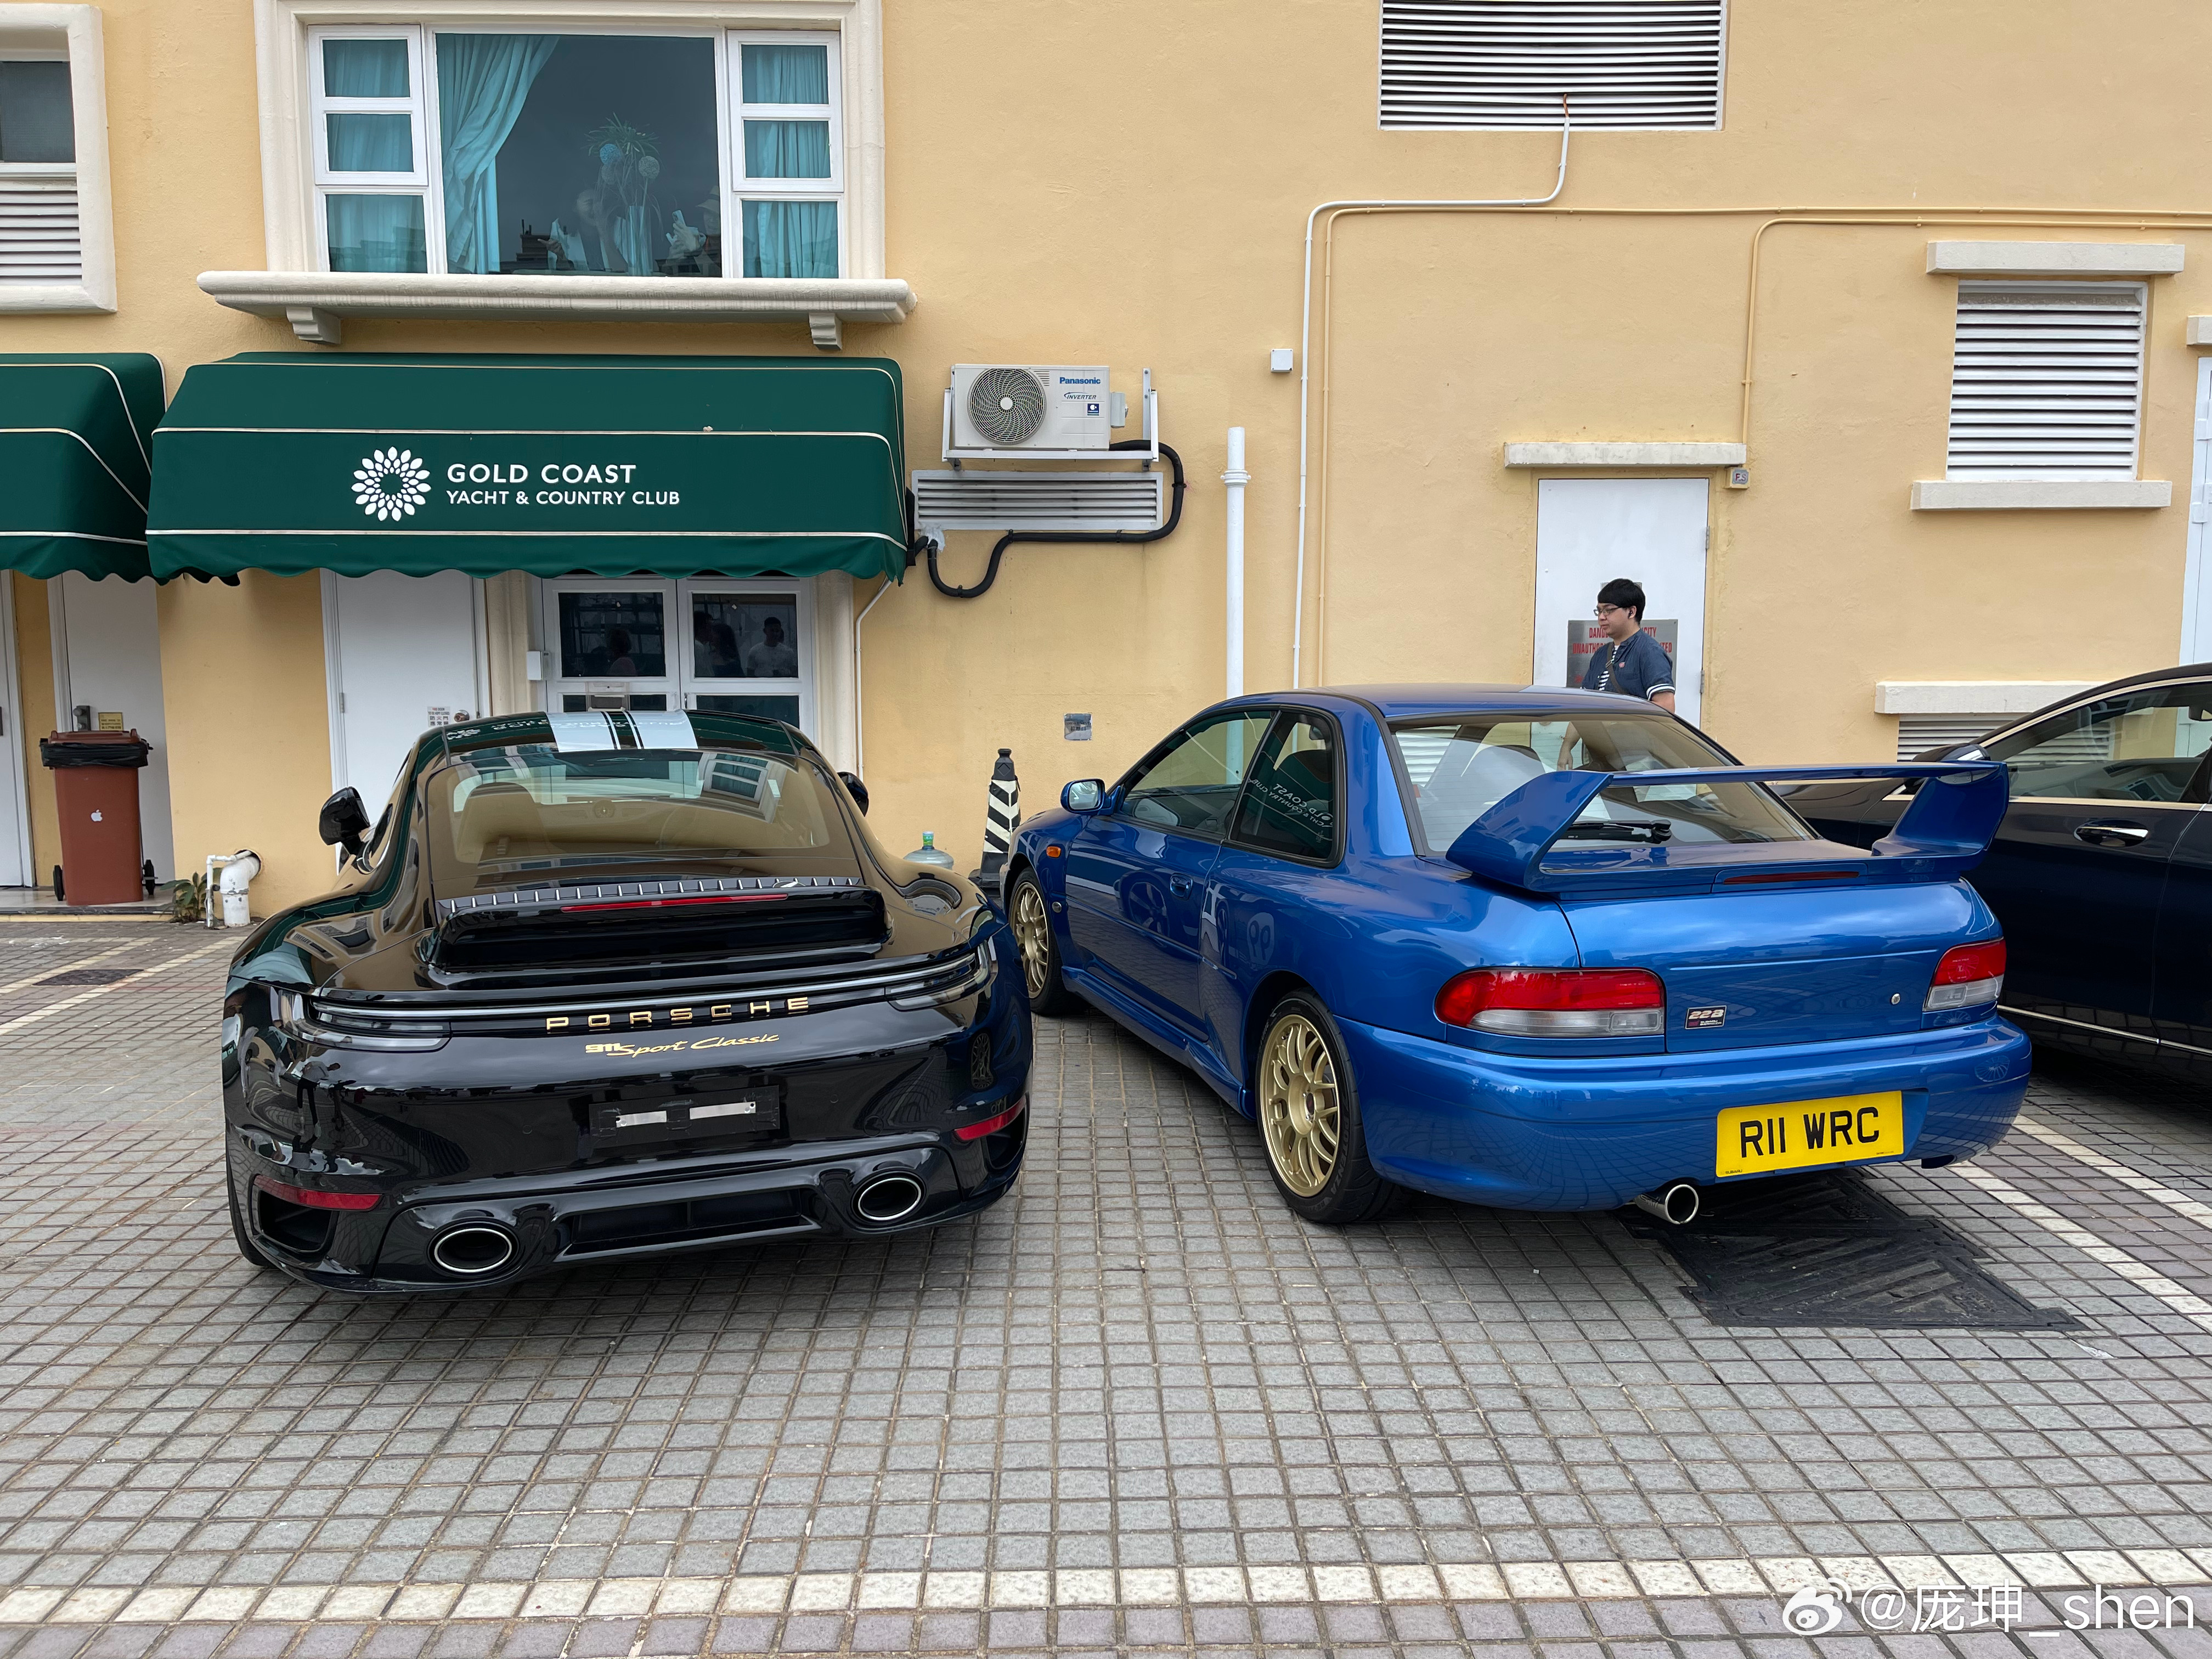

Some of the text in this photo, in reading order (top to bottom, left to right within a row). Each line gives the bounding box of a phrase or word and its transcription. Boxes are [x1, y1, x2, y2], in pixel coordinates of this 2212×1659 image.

[447, 464, 636, 484] GOLD COAST
[446, 490, 680, 505] YACHT & COUNTRY CLUB
[546, 997, 809, 1030] PORSCHE
[585, 1034, 780, 1058] 911 Sport Classic
[1740, 1107, 1880, 1158] R11 WRC
